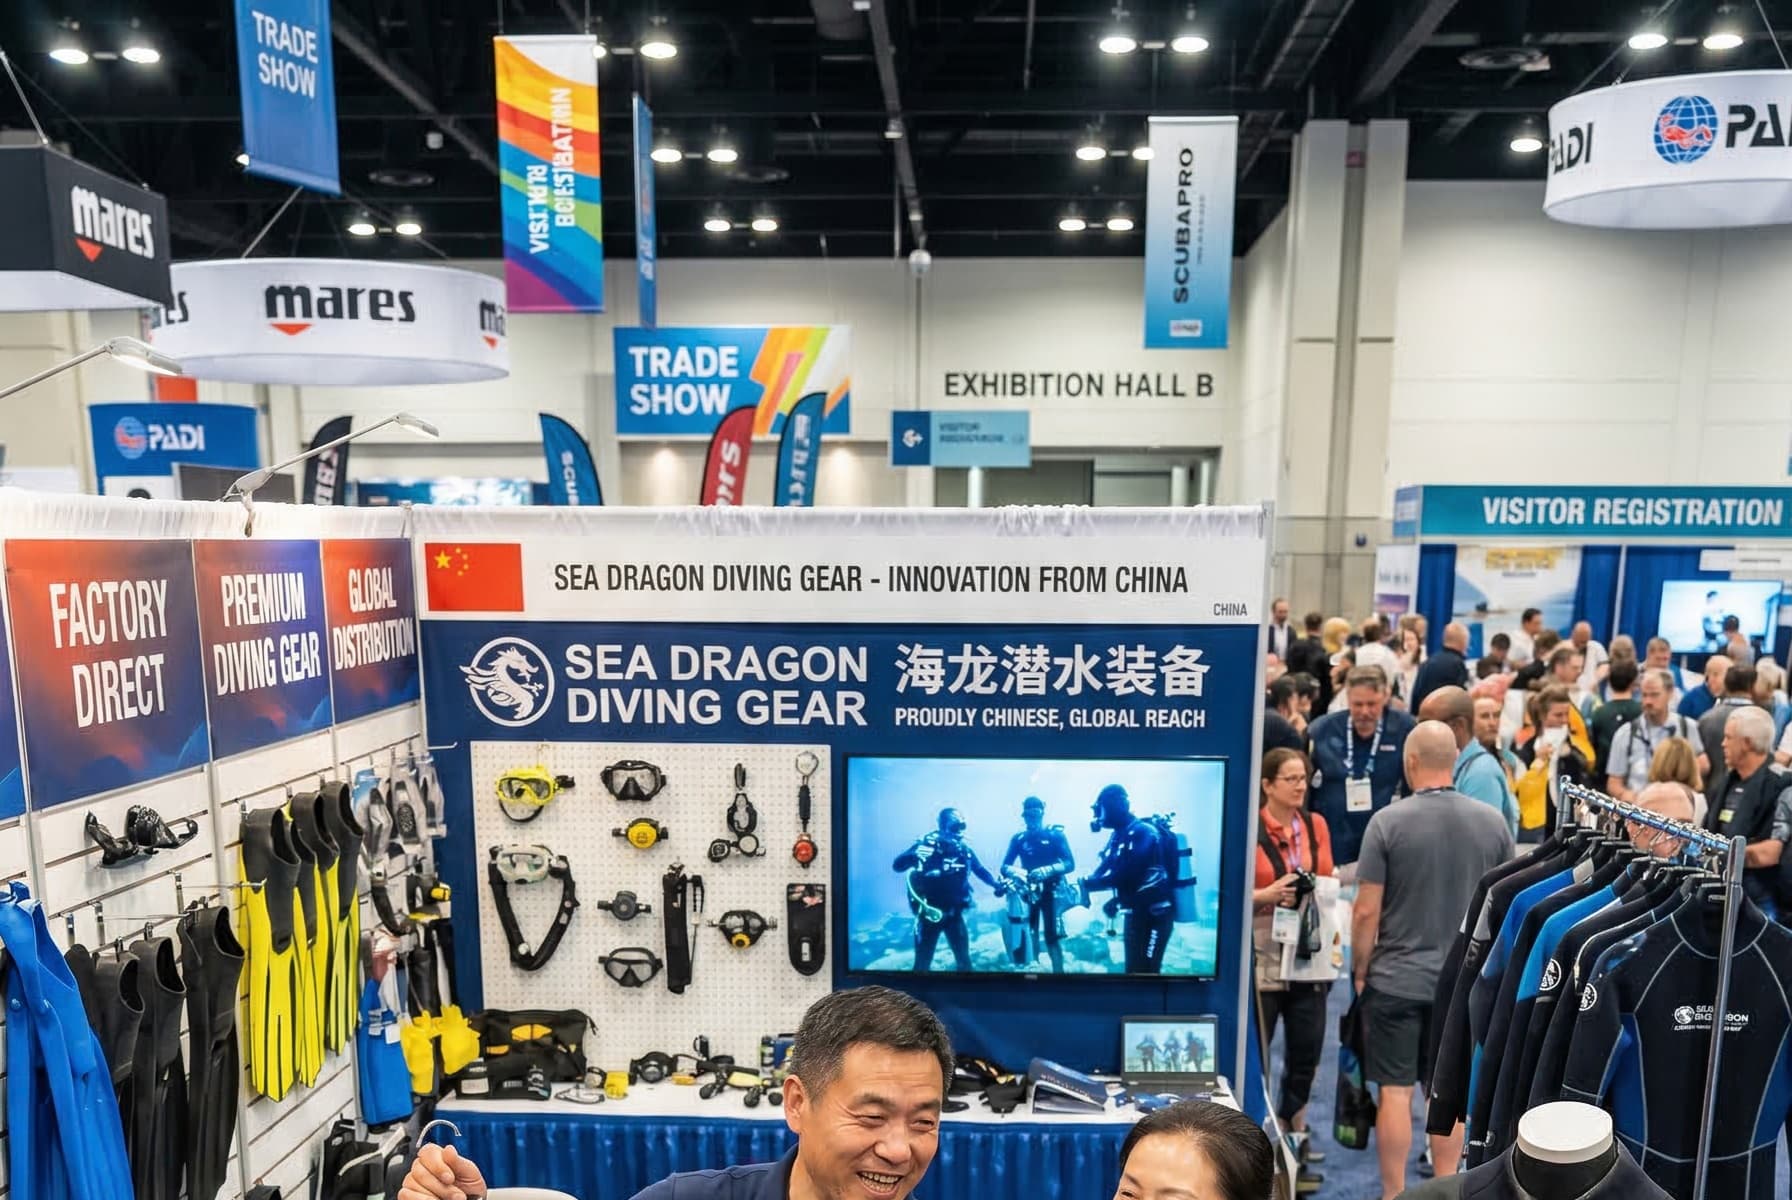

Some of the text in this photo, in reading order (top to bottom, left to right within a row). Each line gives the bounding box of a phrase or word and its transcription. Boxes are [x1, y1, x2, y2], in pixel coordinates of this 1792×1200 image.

[252, 12, 318, 64] TRADE
[258, 54, 316, 99] SHOW
[1725, 103, 1792, 148] PA
[71, 185, 154, 259] mares
[1173, 147, 1194, 305] SCUBAPRO
[265, 284, 416, 323] mares
[629, 346, 739, 378] TRADE
[630, 384, 729, 415] SHOW
[945, 373, 1213, 398] EXHIBITION HALL B
[148, 424, 206, 451] PADI
[1482, 497, 1783, 526] VISITOR REGISTRATION
[221, 572, 306, 627] PREMIUM
[348, 567, 397, 614] GLOBAL
[554, 564, 599, 592] SEA
[607, 564, 704, 592] DRAGON
[712, 565, 791, 592] DIVING
[800, 565, 862, 592] GEAR
[889, 565, 1031, 593] INNOVATION
[1039, 566, 1106, 593] FROM
[1115, 566, 1189, 593] CHINA
[49, 579, 168, 649] FACTORY
[1213, 603, 1248, 617] CHINA
[213, 631, 322, 696] DIVING GEAR
[333, 617, 415, 671] DISTRIBUTION
[565, 644, 867, 682] SEA DRAGON
[72, 653, 166, 728] DIRECT
[894, 643, 1211, 697] 海龙潜水装备
[568, 688, 867, 727] DIVING GEAR
[895, 707, 1205, 731] PROUDLY CHINESE, GLOBAL REACH
